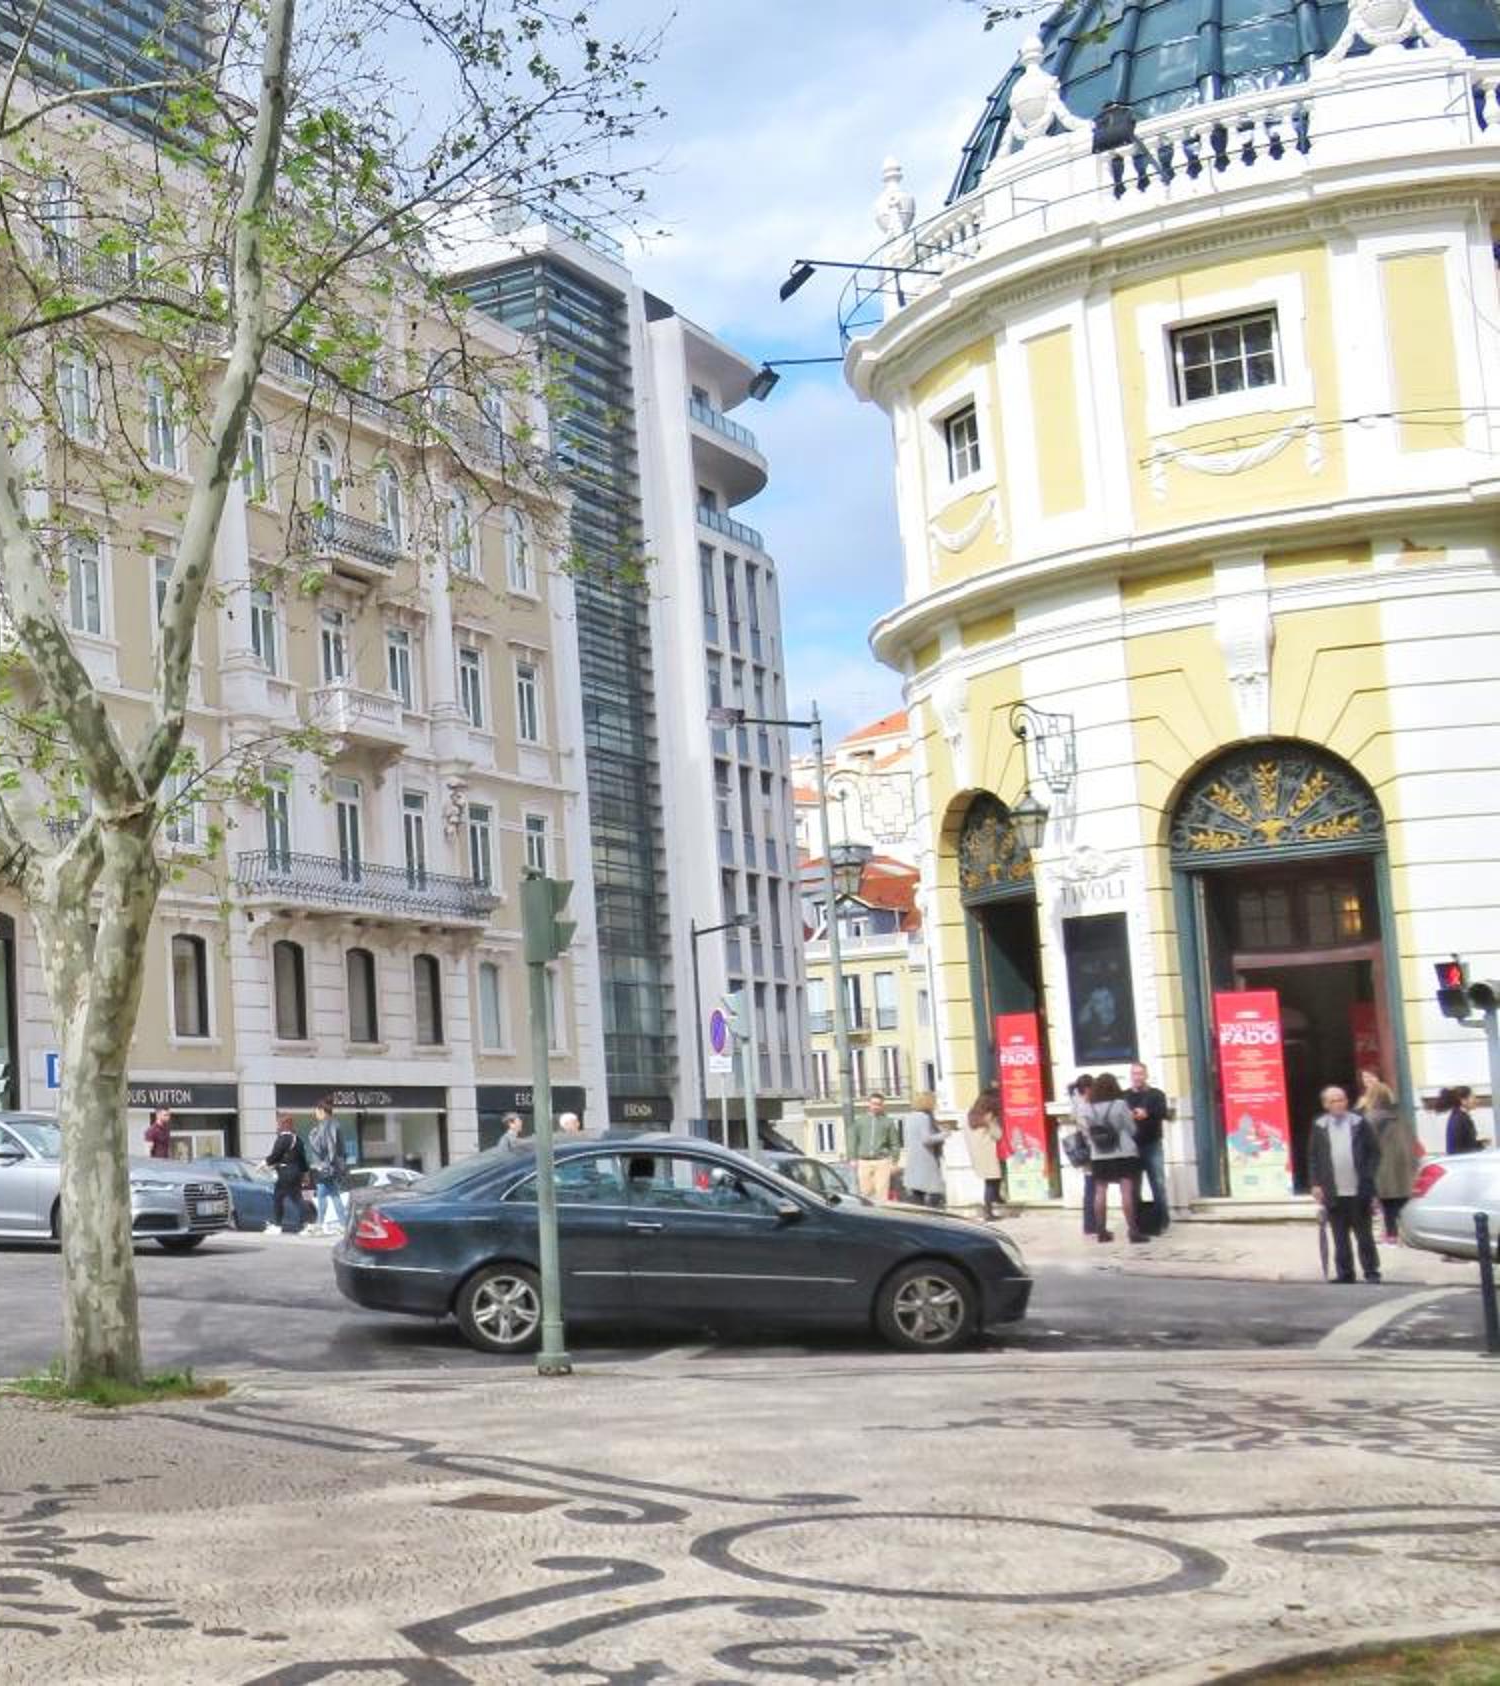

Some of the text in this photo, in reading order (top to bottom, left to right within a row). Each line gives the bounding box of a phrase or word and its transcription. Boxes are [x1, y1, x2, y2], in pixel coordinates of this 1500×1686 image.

[1060, 879, 1126, 905] TIVOLI
[1219, 1031, 1279, 1046] FADO
[1000, 1053, 1038, 1067] FADO
[148, 1088, 191, 1104] VUITTON
